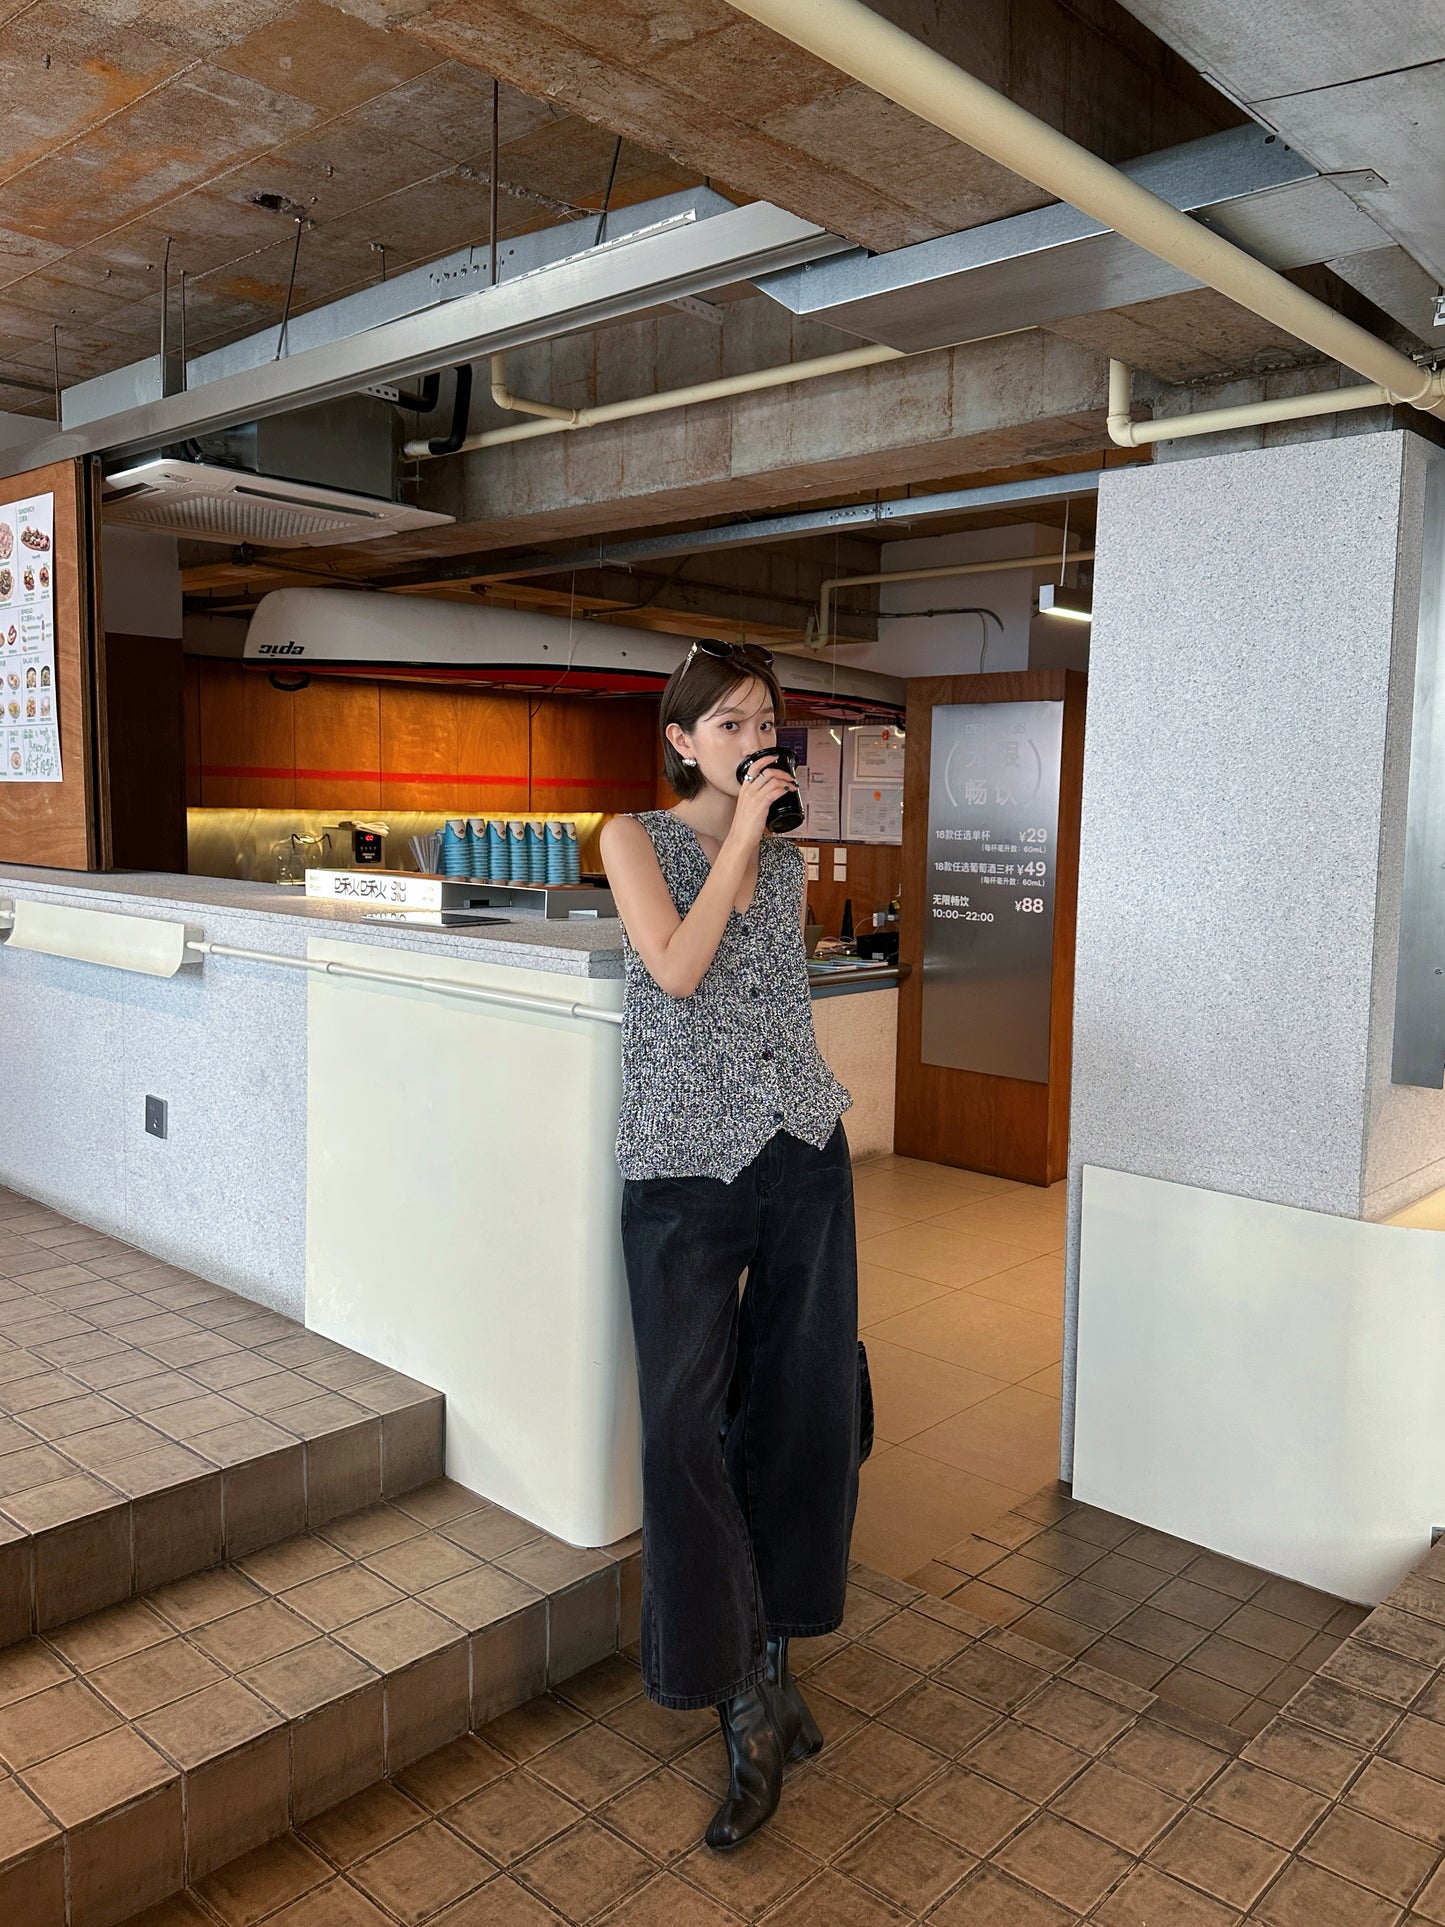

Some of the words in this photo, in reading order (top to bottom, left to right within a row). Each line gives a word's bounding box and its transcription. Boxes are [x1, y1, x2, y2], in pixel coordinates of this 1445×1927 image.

[258, 641, 305, 657] epic
[936, 829, 990, 841] 18款任选单杯
[1019, 828, 1048, 843] ¥29
[934, 861, 1014, 875] 18款任选葡萄酒三杯
[1017, 861, 1046, 877] ¥49
[932, 894, 970, 907] 无限畅饮
[1014, 897, 1044, 913] ¥88
